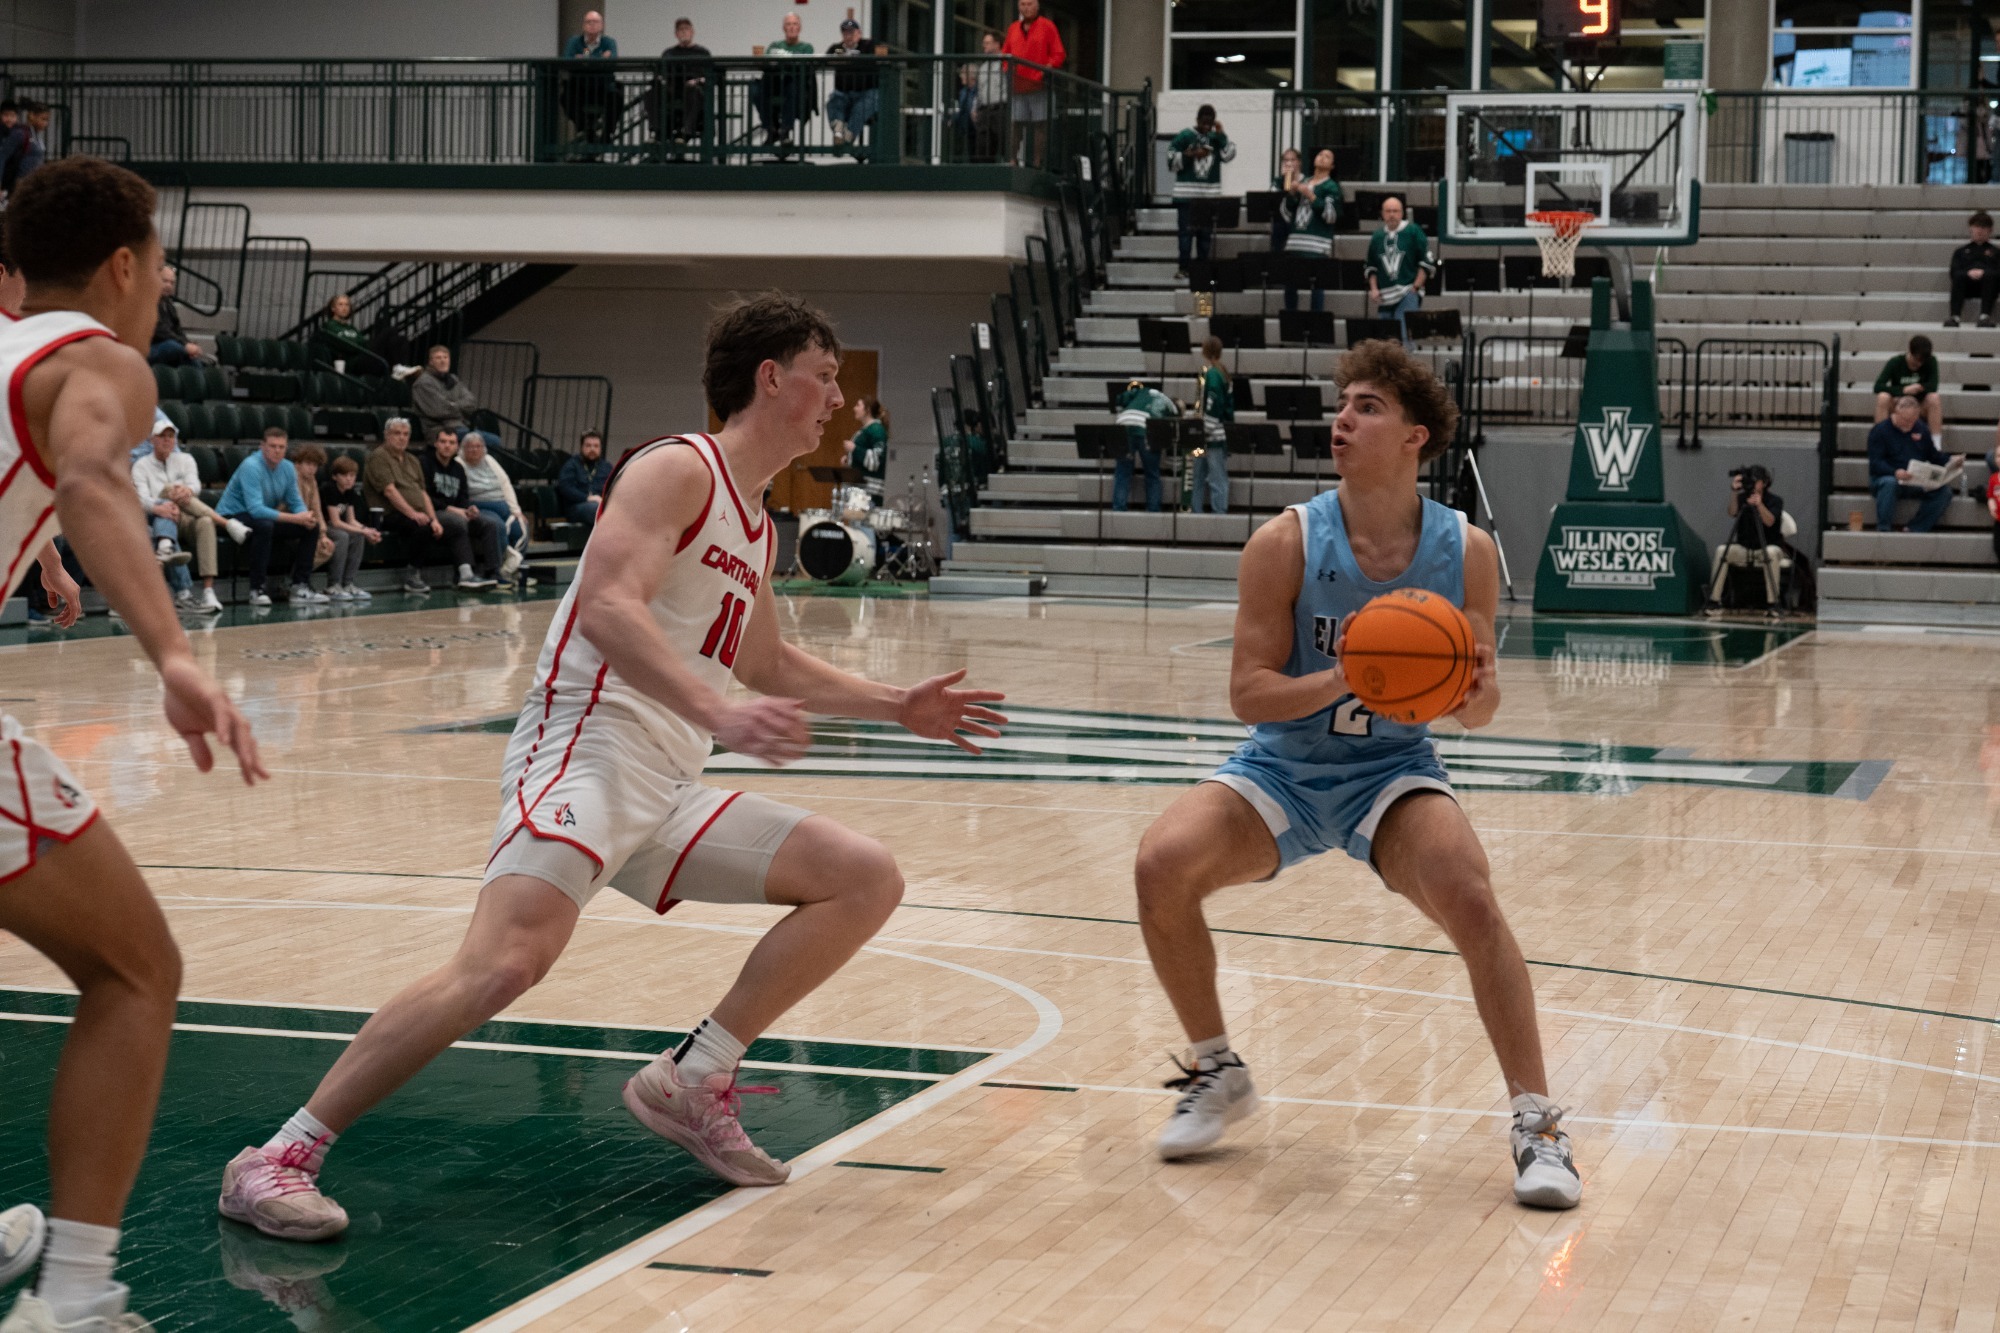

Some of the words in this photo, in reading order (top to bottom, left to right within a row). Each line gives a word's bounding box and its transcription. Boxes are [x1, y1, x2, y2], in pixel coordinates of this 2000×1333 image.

[1580, 0, 1608, 34] 9
[1567, 531, 1658, 551] ILLINOIS
[1556, 551, 1668, 572] WESLEYAN
[699, 591, 746, 669] 10
